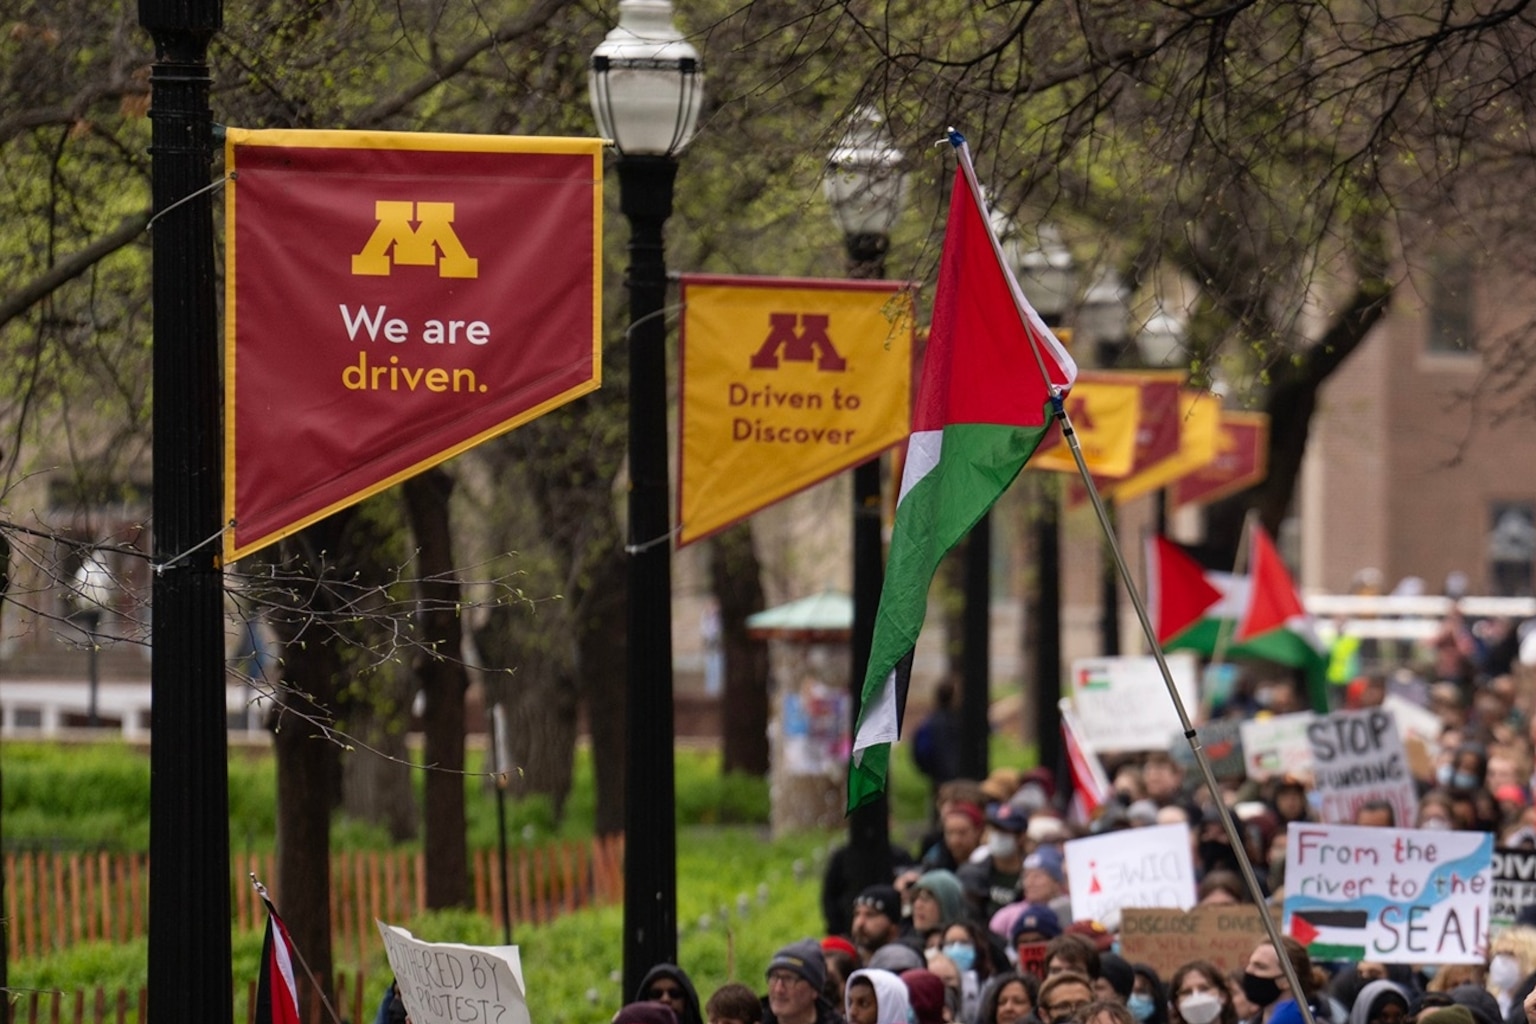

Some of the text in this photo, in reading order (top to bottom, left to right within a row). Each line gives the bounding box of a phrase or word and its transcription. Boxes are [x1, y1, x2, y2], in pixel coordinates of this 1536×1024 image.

[339, 304, 491, 345] We are
[341, 351, 488, 392] driven.
[729, 382, 861, 411] Driven to
[732, 417, 856, 445] Discover
[1306, 709, 1390, 762] STOP
[1298, 830, 1438, 866] From the
[1300, 872, 1487, 898] river to the
[1123, 914, 1202, 935] DISCLOSE
[470, 954, 500, 1002] BY
